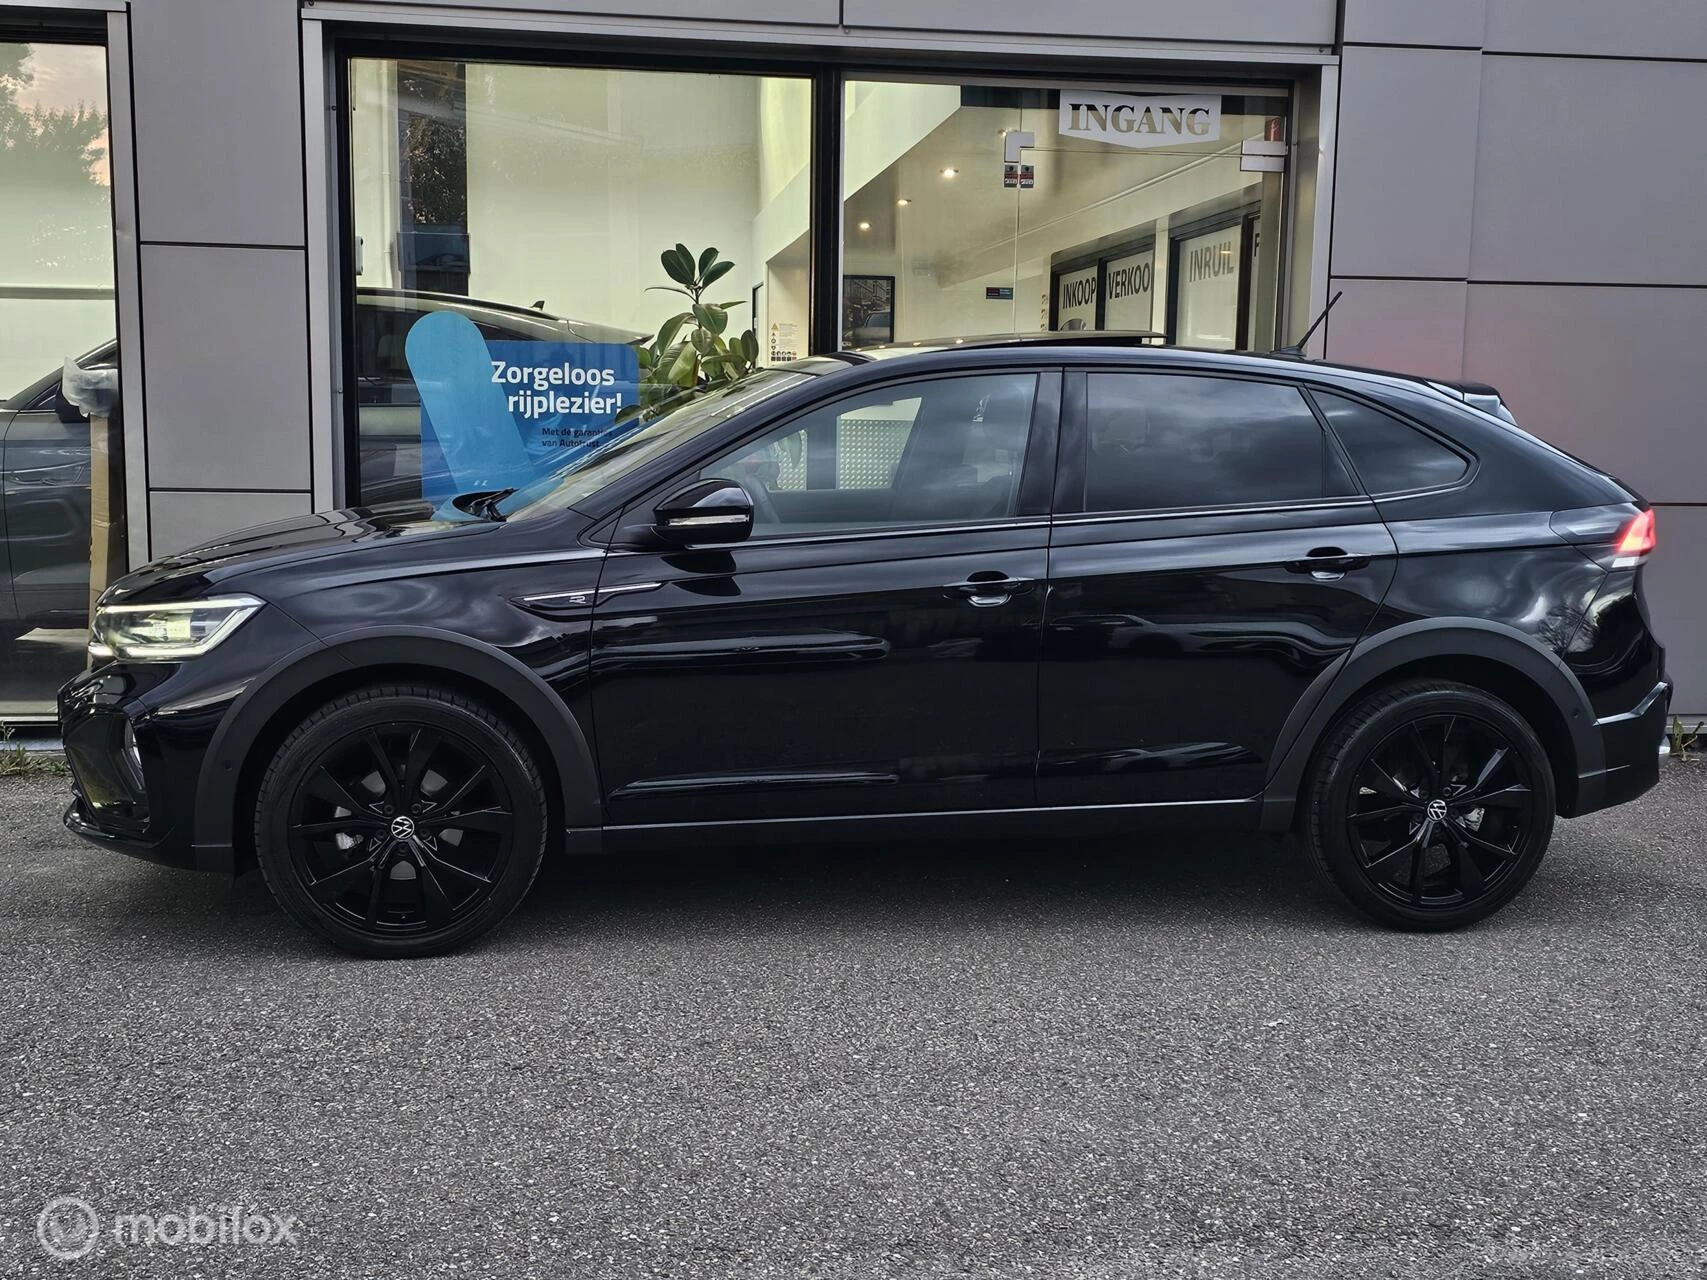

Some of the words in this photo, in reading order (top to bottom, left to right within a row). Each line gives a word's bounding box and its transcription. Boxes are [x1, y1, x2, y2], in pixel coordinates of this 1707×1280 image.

[1068, 103, 1212, 136] INGANG
[1188, 241, 1235, 283] INRUIL
[1062, 276, 1097, 310] INKOOP
[1107, 262, 1152, 300] VERKOO
[491, 361, 615, 391] Zorgeloos
[508, 390, 622, 419] rijplezier!
[542, 427, 559, 436] Met
[560, 427, 572, 436] de
